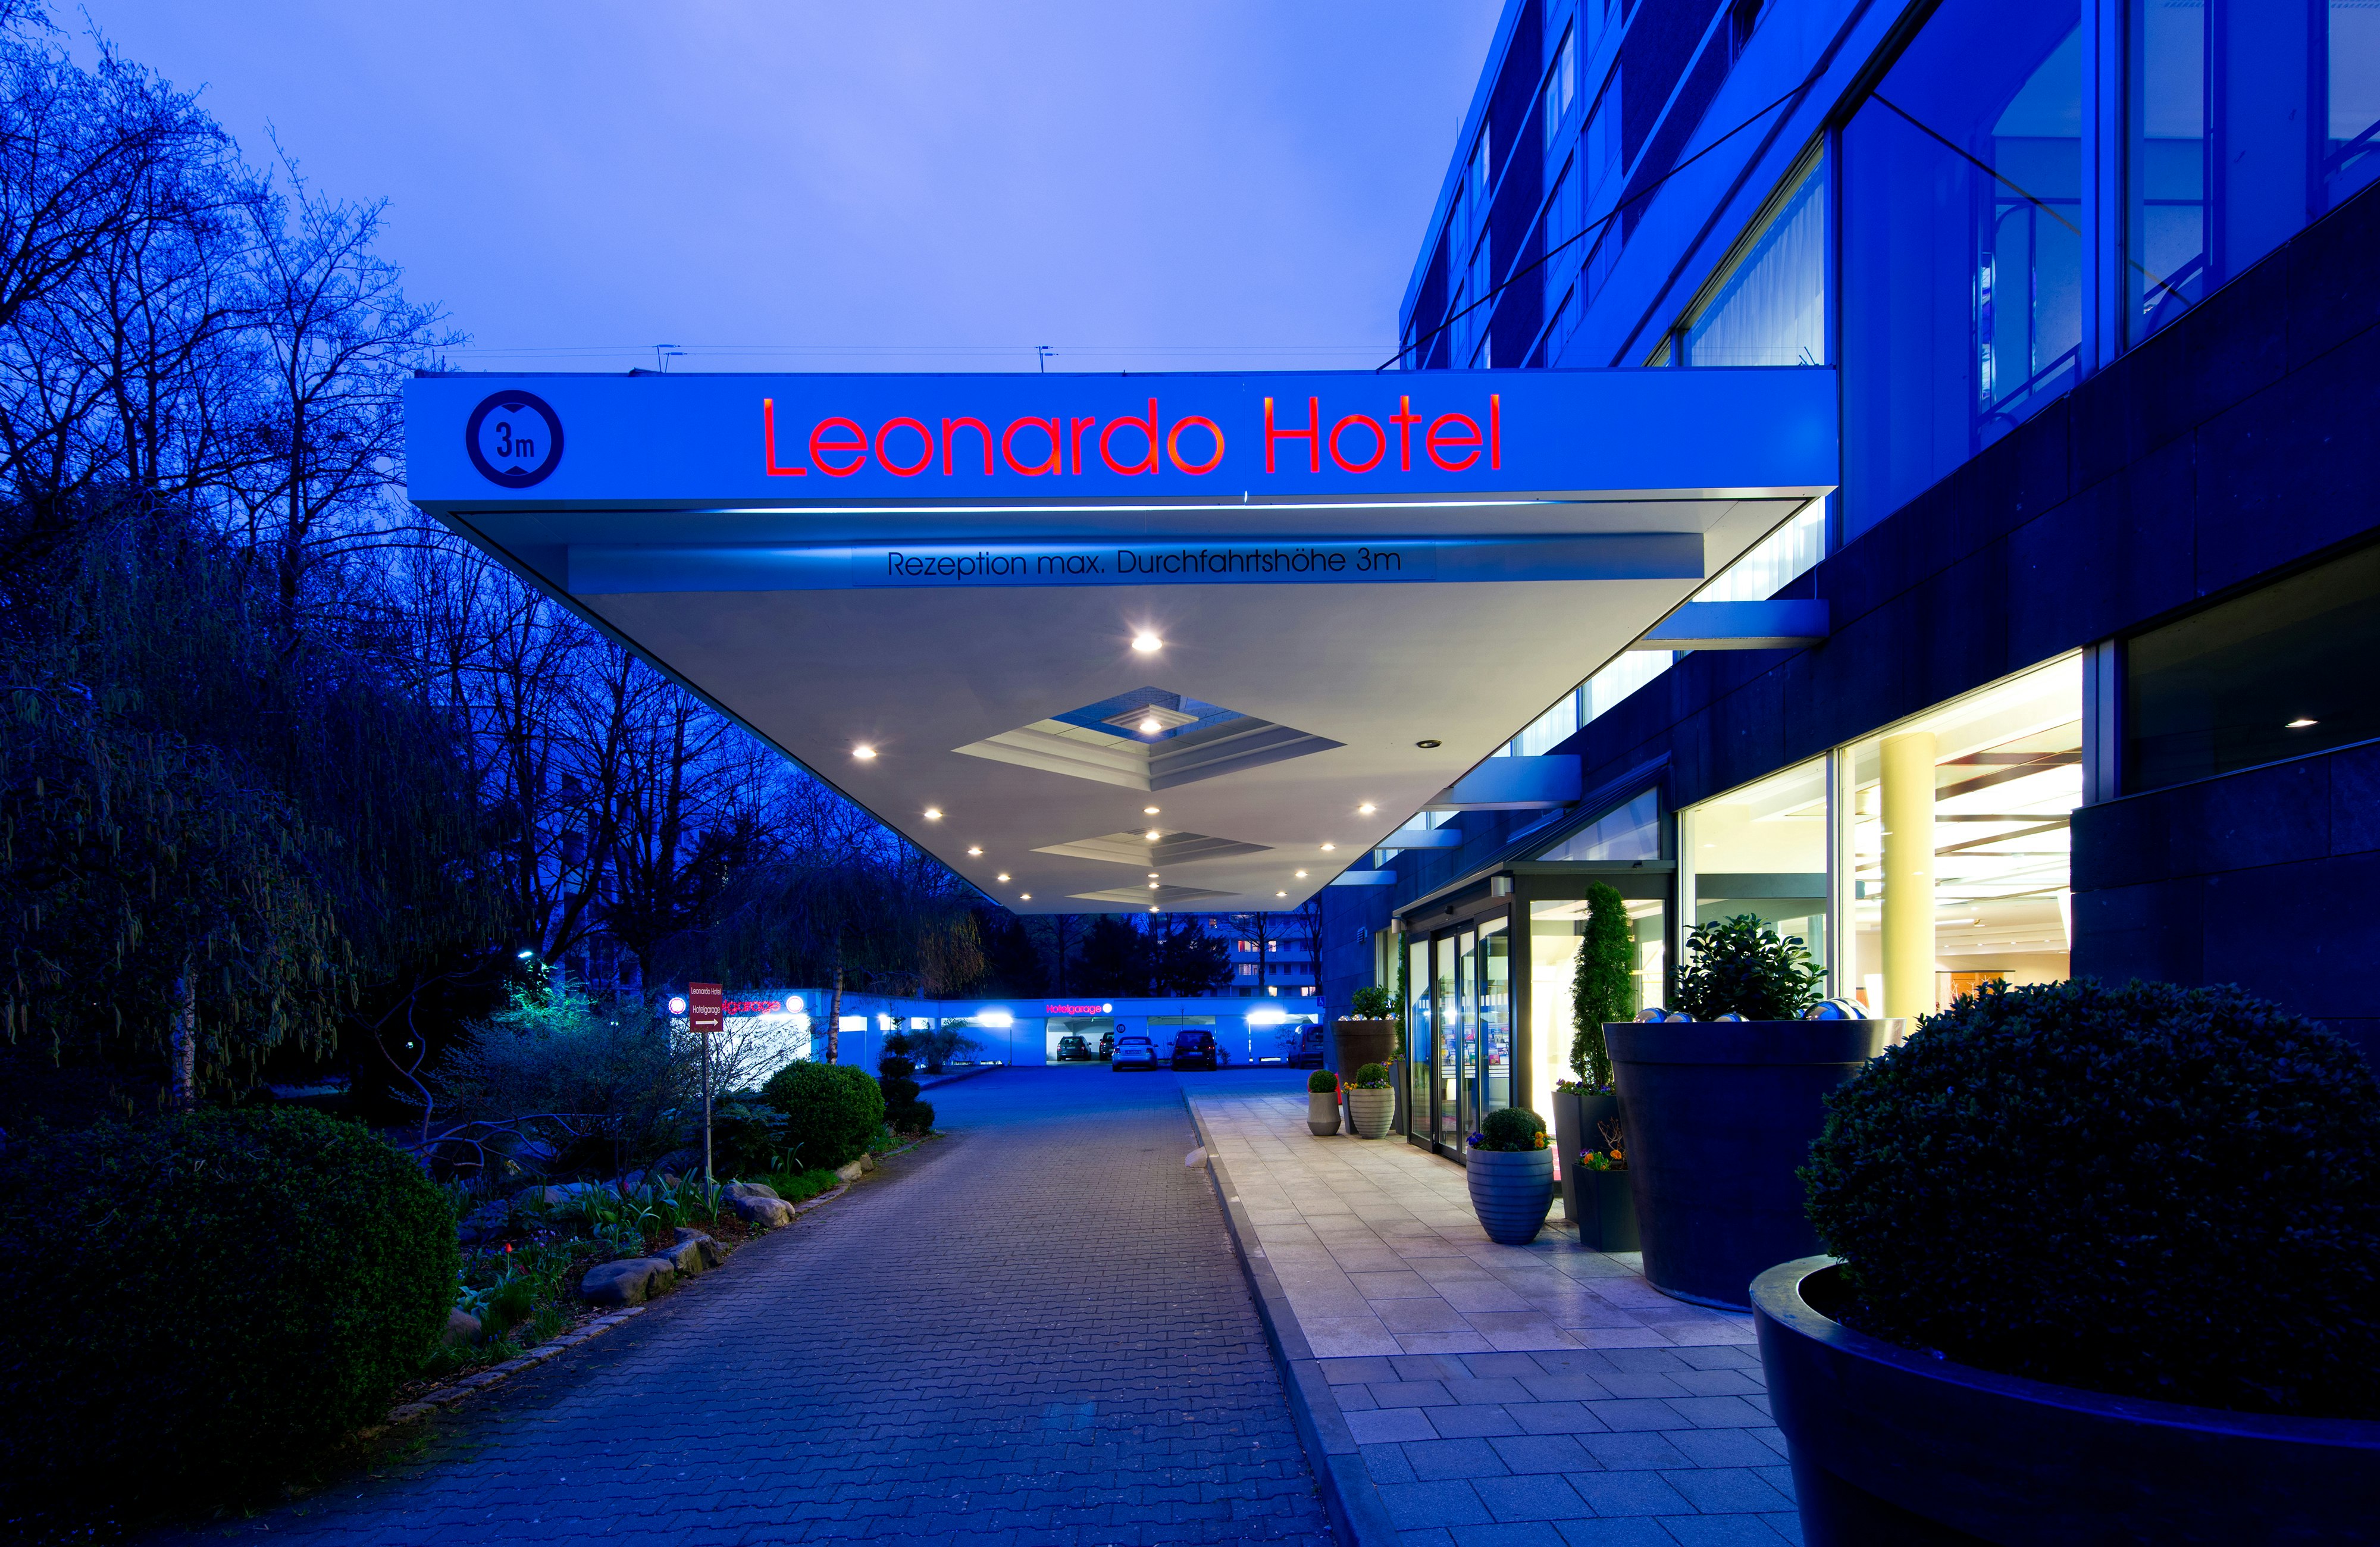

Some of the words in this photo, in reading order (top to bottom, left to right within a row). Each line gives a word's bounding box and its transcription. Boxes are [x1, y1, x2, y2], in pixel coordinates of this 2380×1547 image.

[496, 421, 534, 458] 3m
[763, 397, 1225, 477] Leonardo
[1264, 393, 1501, 474] Hotel
[888, 550, 1027, 581] Rezeption
[1037, 553, 1106, 575] max.
[1117, 547, 1346, 575] Durchfahrtshöhe
[1356, 547, 1402, 572] 3m
[693, 1005, 721, 1015] Hotelgarage
[1046, 1004, 1101, 1014] Hotelgarage
